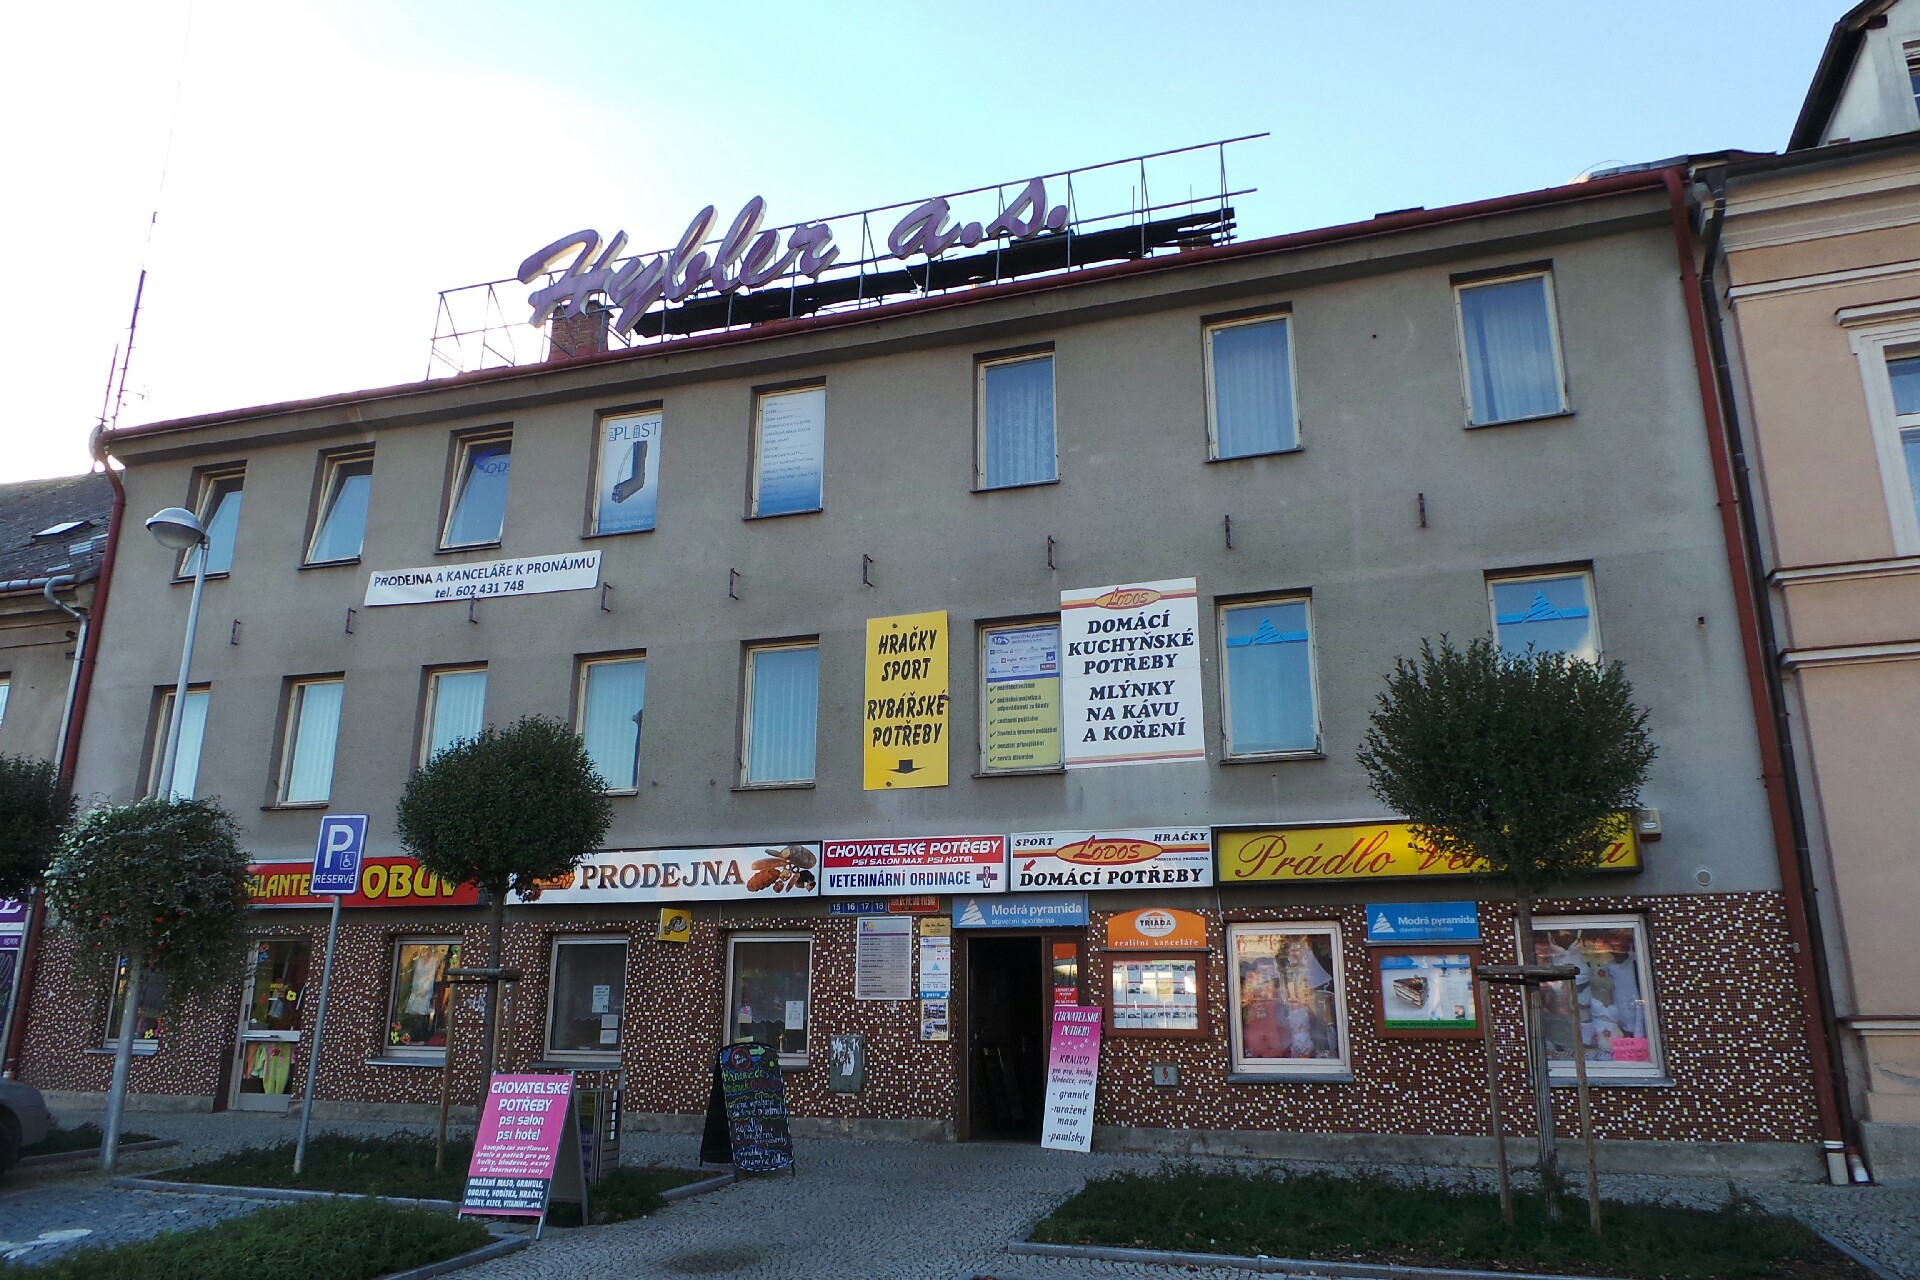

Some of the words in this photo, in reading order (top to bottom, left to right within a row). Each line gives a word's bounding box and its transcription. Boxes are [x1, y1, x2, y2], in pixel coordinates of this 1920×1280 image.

[517, 195, 840, 335] Hybler
[374, 569, 433, 588] PRODEJNA
[435, 573, 443, 583] A
[446, 562, 513, 582] KANCELÁŘE
[515, 564, 524, 575] K
[526, 556, 596, 575] PRONÁJMU
[434, 587, 452, 599] tel.
[456, 585, 476, 597] 602
[479, 582, 499, 595] 431
[503, 580, 524, 593] 748
[1087, 609, 1170, 635] DOMÁCÍ
[878, 626, 938, 655] HRAČKY
[1068, 628, 1194, 657] KUCHYŇSKÉ
[881, 658, 931, 682] SPORT
[1083, 653, 1178, 675] POTŘEBY
[1089, 680, 1176, 701] MLÝNKY
[867, 689, 946, 721] RYBÁŘSKÉ
[1086, 707, 1116, 722] NA
[1122, 699, 1180, 719] KÁVU
[872, 719, 943, 748] POTŘEBY
[1082, 728, 1097, 742] A
[1103, 717, 1186, 741] KOŘENÍ
[1015, 837, 1054, 846] SPORT
[1153, 831, 1208, 842] HRAČKY
[323, 825, 354, 868] P
[827, 841, 926, 858] CHOVATELSKÉ
[929, 839, 1001, 855] POTŘEBY
[1234, 829, 1397, 878] Prádlo
[869, 857, 900, 865] SALON
[945, 855, 975, 863] HOTEL
[315, 873, 354, 884] RÉSERVÉ
[579, 859, 745, 890] PRODEJNA
[829, 870, 905, 888] VETERINÁRNÍ
[910, 870, 971, 886] ORDINACE
[1019, 868, 1101, 887] DOMÁCÍ
[1107, 865, 1204, 885] POTŘEBY
[832, 903, 840, 911] 15
[991, 904, 1027, 915] Modrá
[1029, 903, 1082, 916] pyramida
[1398, 917, 1429, 925] Modrá
[1431, 915, 1476, 926] pyramida
[1114, 939, 1149, 947] realitní
[1154, 938, 1199, 946] kanceláře
[491, 1081, 569, 1095] CHOVATELSKÉ
[1059, 1090, 1090, 1100] granule
[498, 1096, 553, 1112] POTŘEBY
[517, 1113, 544, 1126] salon
[1057, 1117, 1078, 1126] maso
[515, 1128, 541, 1141] hotel
